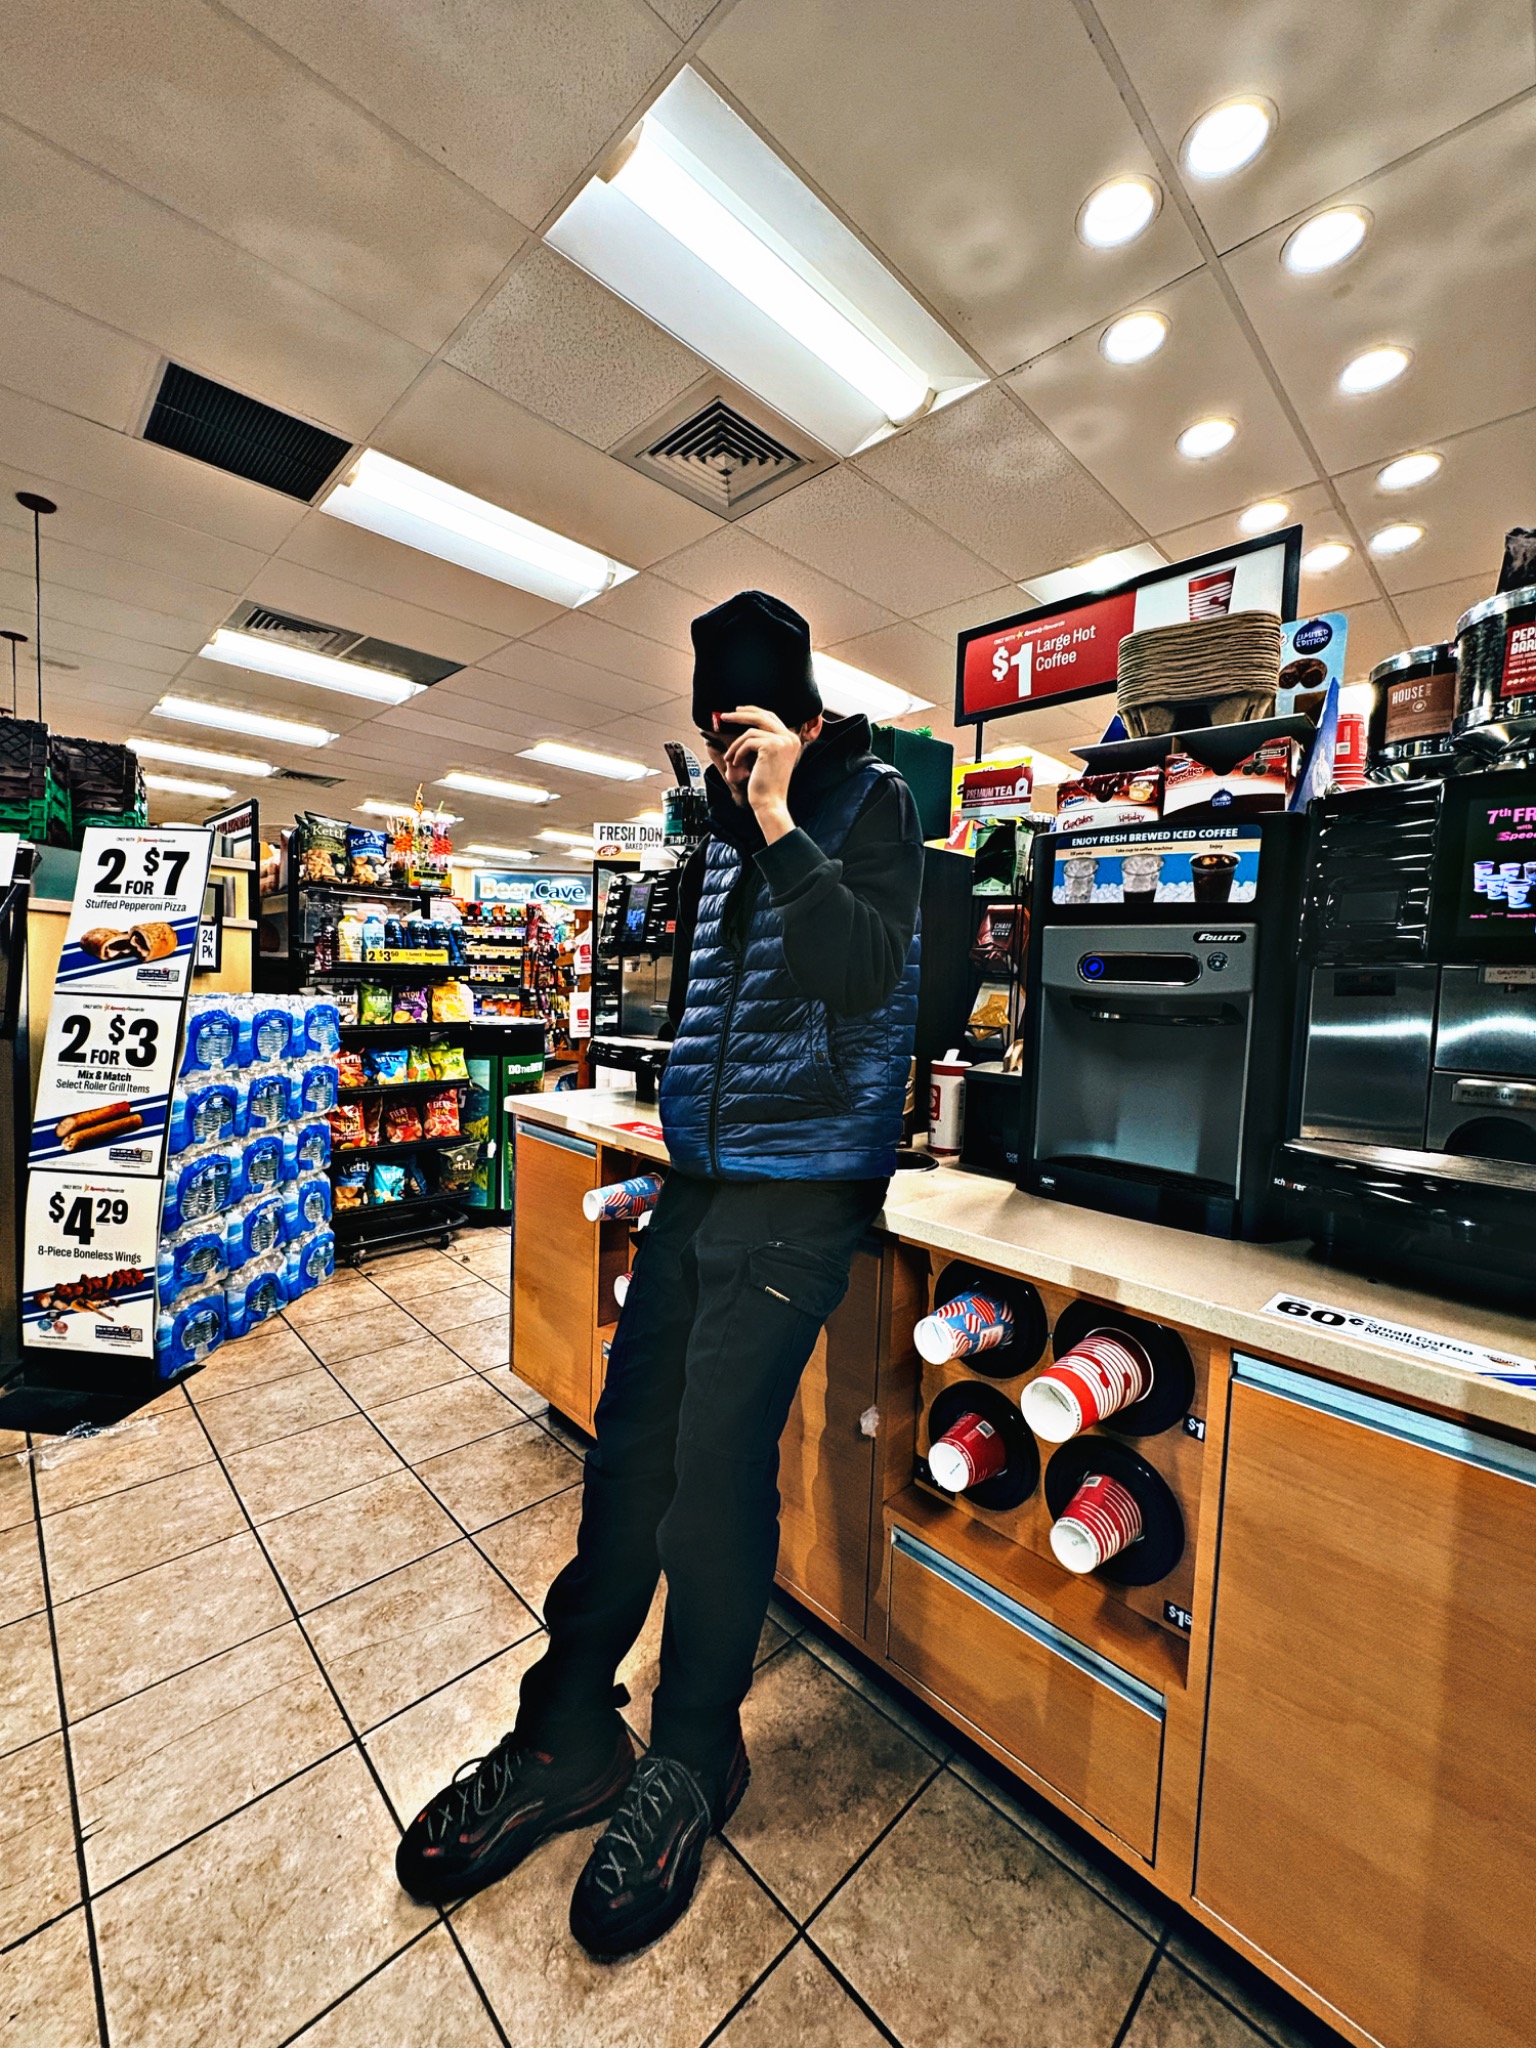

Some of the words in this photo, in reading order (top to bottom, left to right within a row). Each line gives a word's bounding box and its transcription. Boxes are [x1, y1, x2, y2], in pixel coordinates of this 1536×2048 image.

[1036, 634, 1071, 653] Large
[1073, 625, 1097, 644] Hot
[1296, 628, 1329, 642] LIMITED
[1511, 626, 1536, 643] PEP
[1510, 639, 1536, 655] BAR
[1036, 650, 1077, 672] Coffee
[991, 641, 1033, 698] $1
[1392, 684, 1425, 705] HOUSE
[1168, 766, 1204, 785] donettes
[966, 787, 995, 800] PREMIUM
[994, 785, 1013, 797] TEA
[1487, 807, 1512, 825] 7th
[312, 824, 346, 839] Kettl
[599, 825, 635, 841] FRESH
[1072, 836, 1098, 847] ENJOY
[1099, 834, 1127, 844] FRESH
[1128, 831, 1171, 842] BREWED
[1172, 830, 1196, 840] ICED
[1198, 828, 1238, 838] COFFEE
[625, 842, 644, 850] BAKED
[94, 848, 126, 894] 2
[125, 880, 154, 895] FOR
[143, 847, 190, 896] $7
[480, 878, 533, 899] Beer
[535, 880, 585, 902] Cave
[85, 899, 118, 910] Stuffed
[119, 900, 163, 912] Pepperoni
[163, 901, 187, 912] Pizza
[202, 929, 213, 943] 24
[1198, 933, 1242, 942] FOLLETT
[202, 945, 213, 959] Pk
[368, 950, 376, 961] 2
[58, 1014, 91, 1063] 2
[90, 1049, 120, 1065] FOR
[108, 1014, 159, 1068] $3
[77, 1070, 94, 1080] Mix
[95, 1071, 102, 1081] &
[103, 1071, 132, 1082] Match
[56, 1078, 82, 1090] Select
[83, 1080, 107, 1091] Roller
[108, 1081, 126, 1092] Grill
[126, 1083, 150, 1094] Items
[1494, 1091, 1516, 1100] CUP
[38, 1245, 72, 1257] 8-Piece
[73, 1248, 114, 1261] Boneless
[115, 1251, 142, 1265] Wings
[1364, 1327, 1440, 1352] Mondays
[1366, 1322, 1413, 1340] Small
[1415, 1333, 1473, 1356] Coffee
